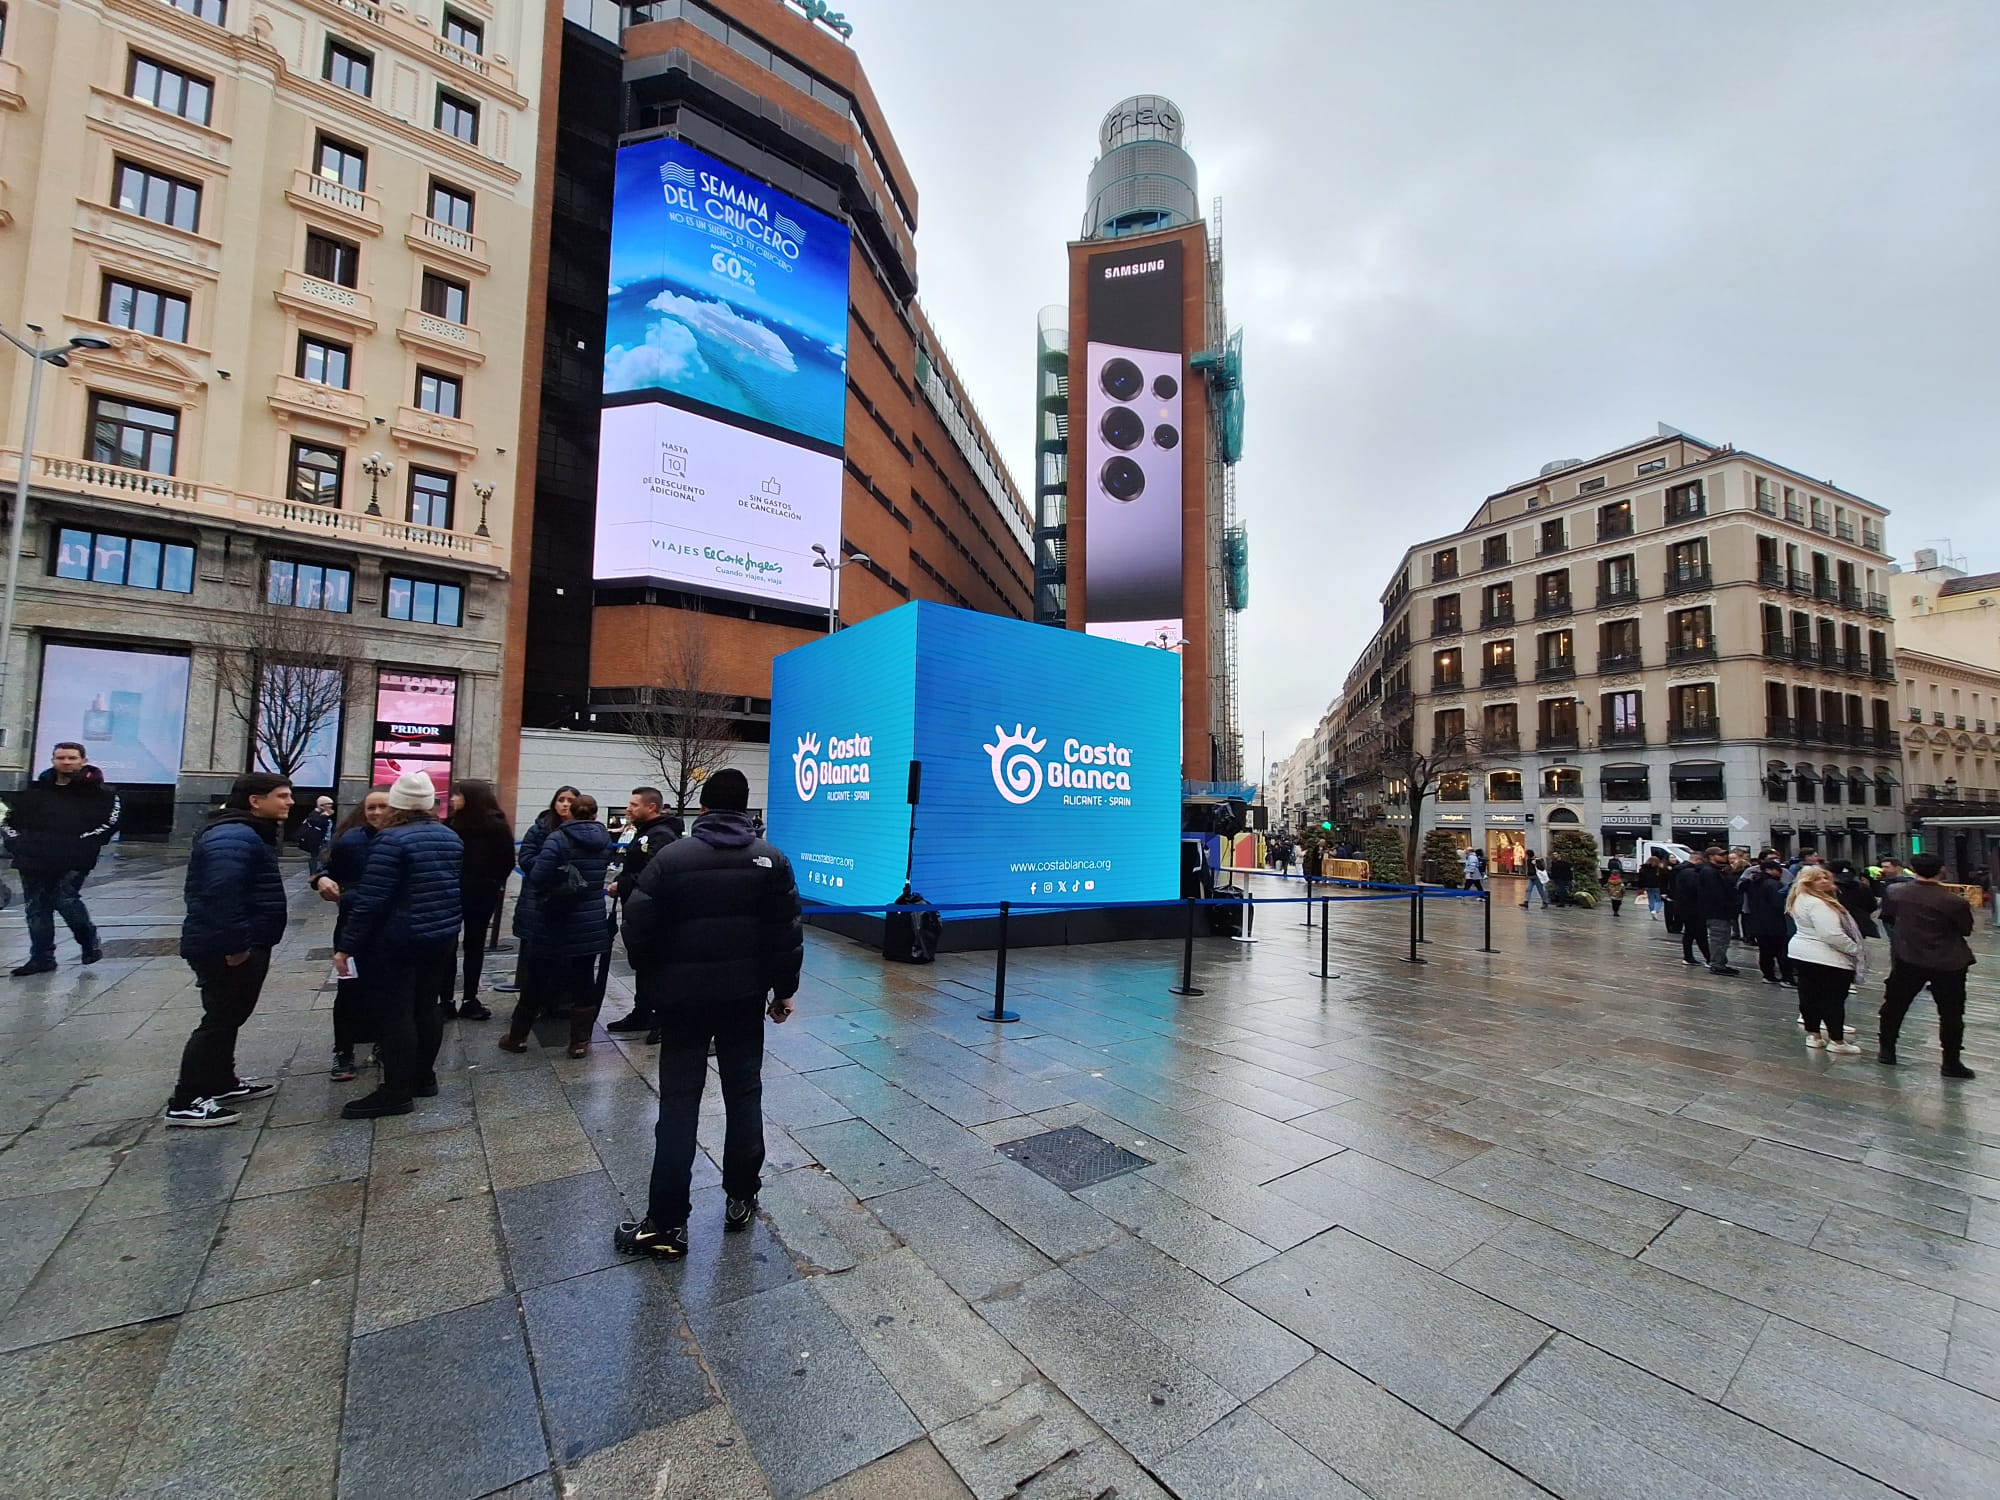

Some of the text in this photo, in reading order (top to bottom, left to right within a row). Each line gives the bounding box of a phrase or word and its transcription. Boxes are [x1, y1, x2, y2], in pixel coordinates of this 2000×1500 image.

[1109, 107, 1177, 141] fnac
[700, 172, 768, 221] SEMANA
[664, 183, 800, 260] DEL CRUCERO
[669, 211, 684, 223] NO
[696, 219, 706, 231] UN
[736, 235, 744, 246] ES
[746, 240, 755, 251] TU
[755, 246, 793, 273] CRUCERO
[711, 252, 756, 286] 60%
[1104, 259, 1165, 279] SAMSUNG
[661, 441, 689, 455] HASTA
[668, 458, 681, 471] 10
[650, 485, 696, 502] ADICIONAL
[654, 477, 705, 496] DESCUENTO
[738, 499, 802, 521] DE CANCELACIÓN
[749, 494, 792, 511] SIN GASTOS
[652, 538, 783, 574] VIAJES El Corte Inglés
[715, 566, 743, 577] Cuando
[390, 724, 440, 736] PRIMOR
[828, 733, 871, 760] Costa
[1063, 738, 1132, 767] Costa
[819, 761, 870, 785] Blanca
[1047, 761, 1132, 791] Blanca
[827, 791, 870, 801] ALICANTE SPAIN
[1063, 794, 1131, 807] ALICANTE SPAIN
[1602, 815, 1650, 824] RODILLA
[1673, 816, 1727, 826] RODILLA
[1010, 857, 1112, 873] www.costablanca.org
